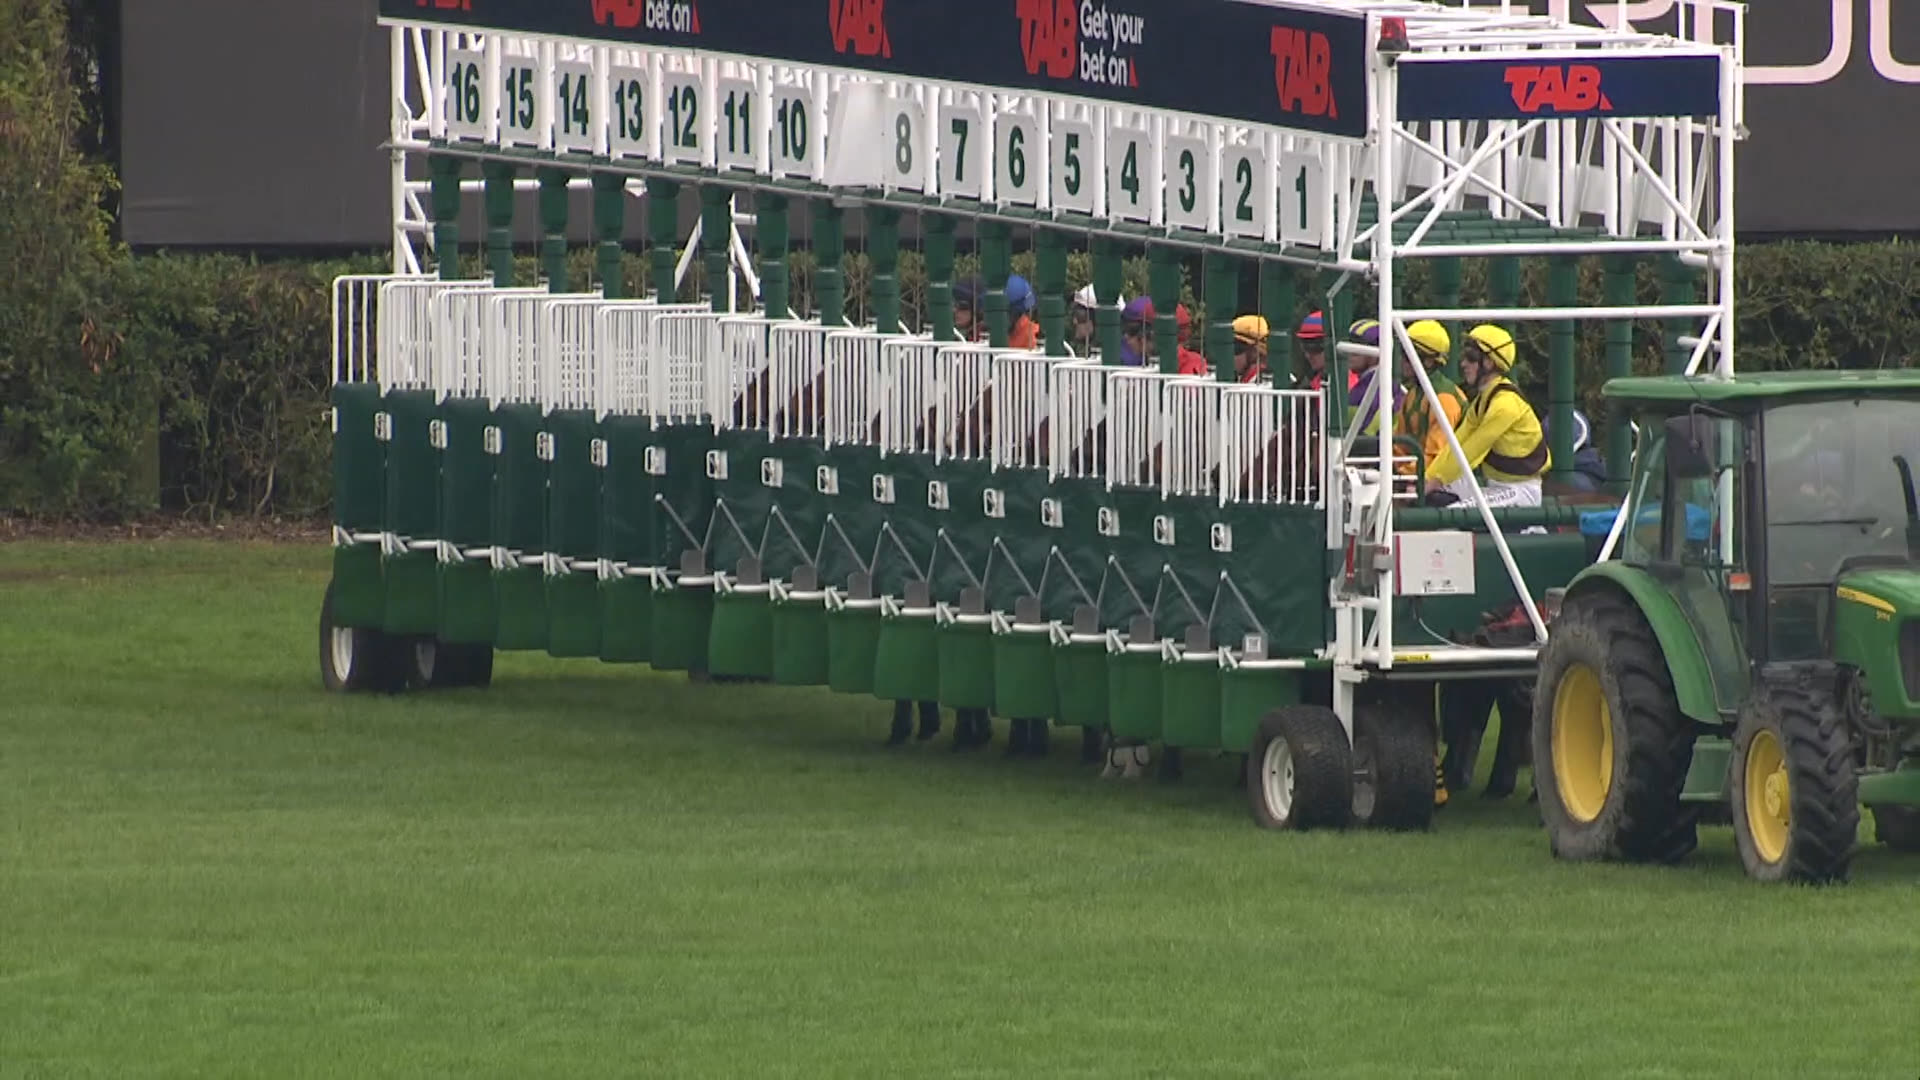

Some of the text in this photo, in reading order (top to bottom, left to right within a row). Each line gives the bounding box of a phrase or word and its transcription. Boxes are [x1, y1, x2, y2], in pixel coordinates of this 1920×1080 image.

[646, 0, 669, 30] bet
[672, 4, 691, 32] on
[1016, 0, 1077, 78] TAB
[1080, 0, 1144, 51] Get your
[452, 61, 480, 124] 16
[1080, 42, 1128, 86] bet on
[1271, 27, 1334, 116] TAB
[1504, 65, 1604, 112] TAB
[506, 67, 535, 131] 15
[559, 72, 589, 137] 14
[615, 79, 643, 142] 13
[668, 85, 697, 148] 12
[724, 90, 750, 155] 11
[777, 98, 807, 162] 10
[895, 112, 912, 175] 8
[952, 118, 969, 183] 7
[1009, 125, 1025, 188] 6
[1064, 132, 1081, 196] 5
[1121, 141, 1139, 205] 4
[1179, 149, 1195, 213] 3
[1236, 157, 1253, 222] 2
[1295, 165, 1307, 230] 1
